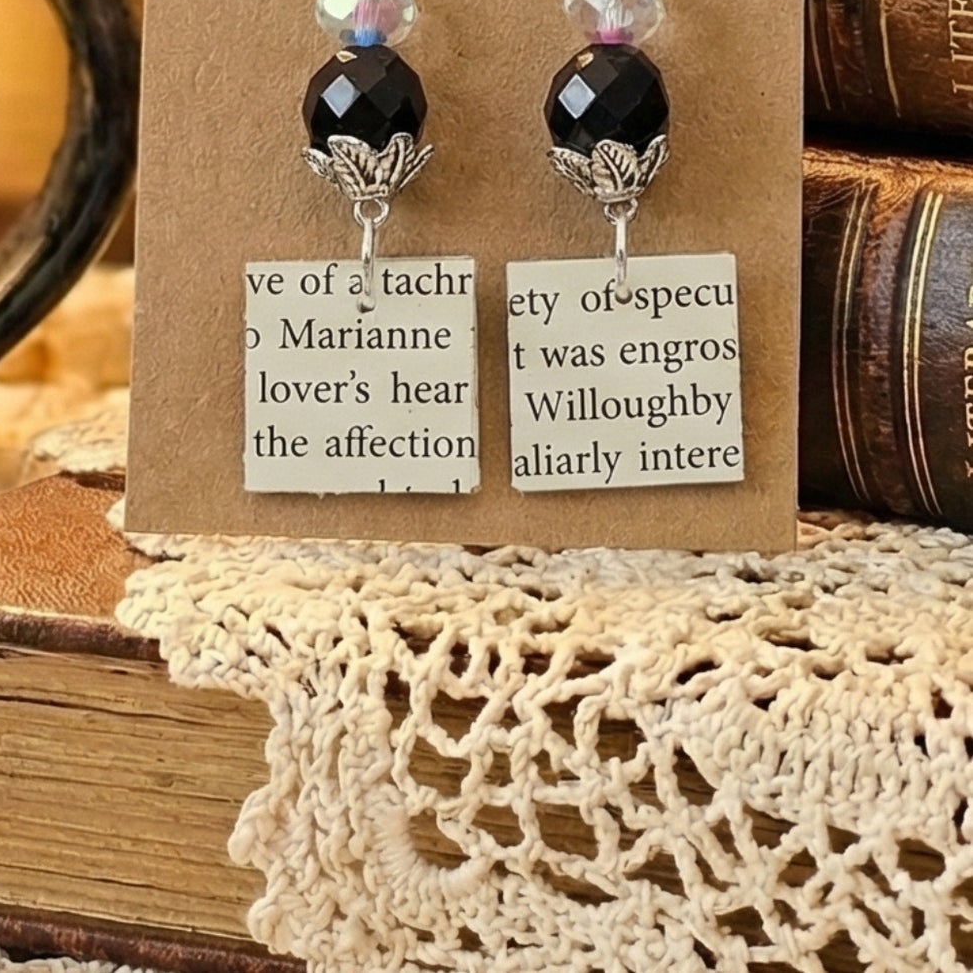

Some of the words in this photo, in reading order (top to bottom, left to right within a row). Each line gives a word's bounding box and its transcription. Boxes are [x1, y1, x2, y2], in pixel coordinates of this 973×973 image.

[246, 273, 284, 294] ve
[300, 263, 338, 294] of
[509, 288, 559, 325] ety
[581, 279, 615, 312] of
[634, 283, 734, 319] specu
[279, 319, 451, 349] Marianne
[513, 342, 525, 369] t
[541, 344, 605, 367] was
[619, 338, 736, 373] engros
[259, 370, 370, 403] lover’s
[391, 371, 469, 403] hear
[525, 383, 732, 428] Willoughby
[254, 425, 308, 457] the
[325, 425, 476, 458] affection
[514, 441, 621, 484] aliarly
[640, 442, 740, 471] intere
